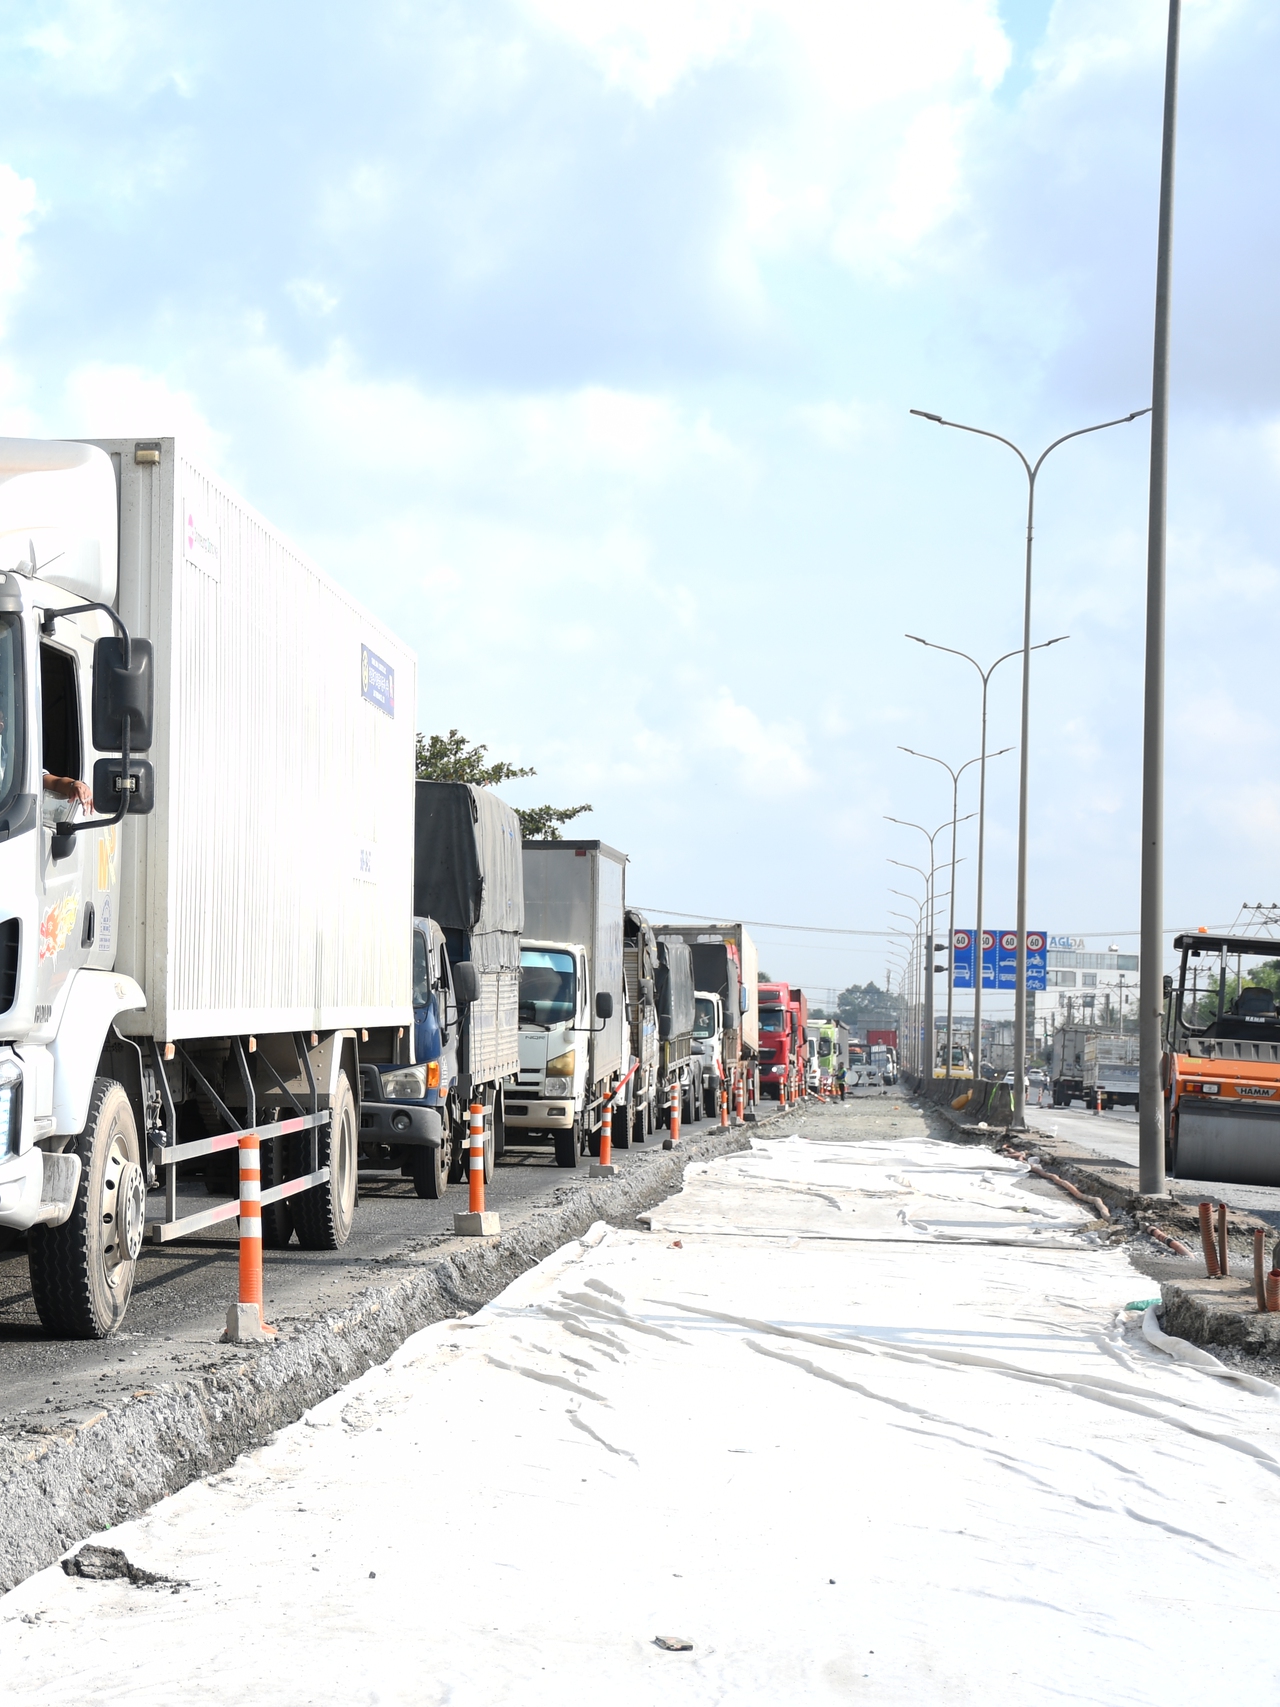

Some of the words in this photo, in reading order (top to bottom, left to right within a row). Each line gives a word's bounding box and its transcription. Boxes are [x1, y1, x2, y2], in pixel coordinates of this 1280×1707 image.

[956, 935, 966, 945] 60
[1005, 937, 1015, 946] 60
[1029, 938, 1040, 947] 60
[1240, 1087, 1270, 1096] HAMM
